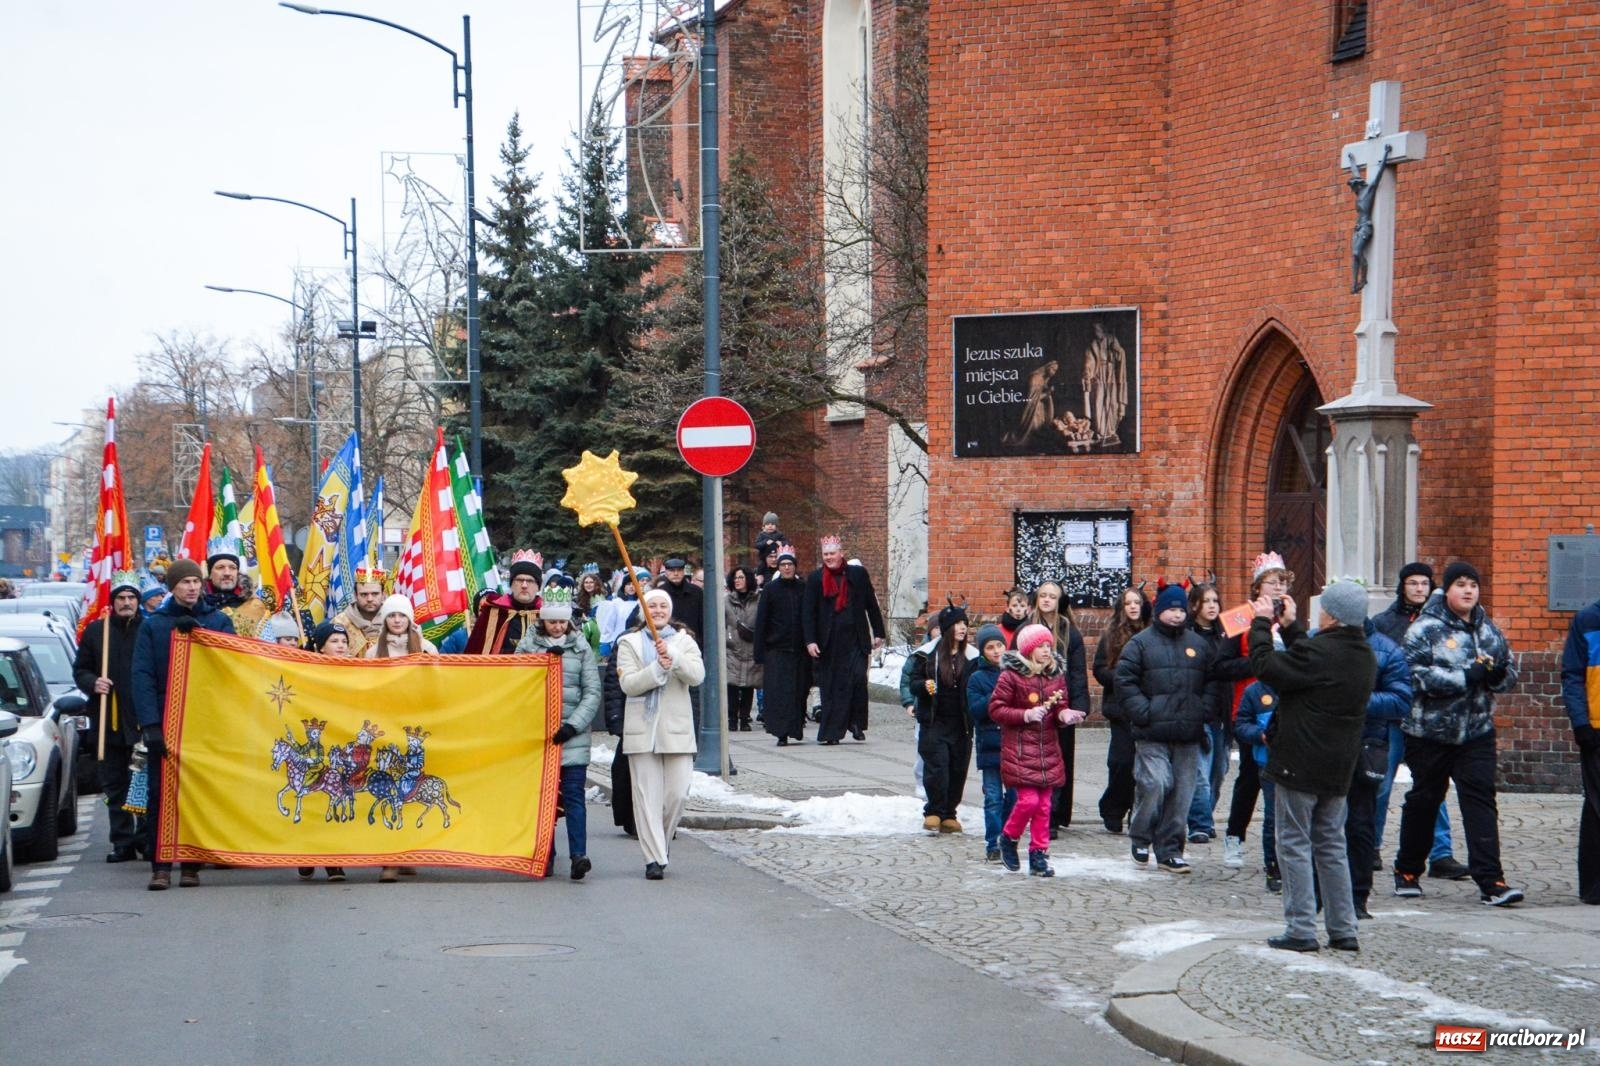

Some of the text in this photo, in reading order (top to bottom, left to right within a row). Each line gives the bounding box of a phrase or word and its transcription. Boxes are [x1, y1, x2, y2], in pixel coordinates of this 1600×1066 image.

[964, 342, 1043, 363] Jezus szuka
[965, 368, 1019, 386] miejsca
[966, 387, 1033, 405] u Ciebie...
